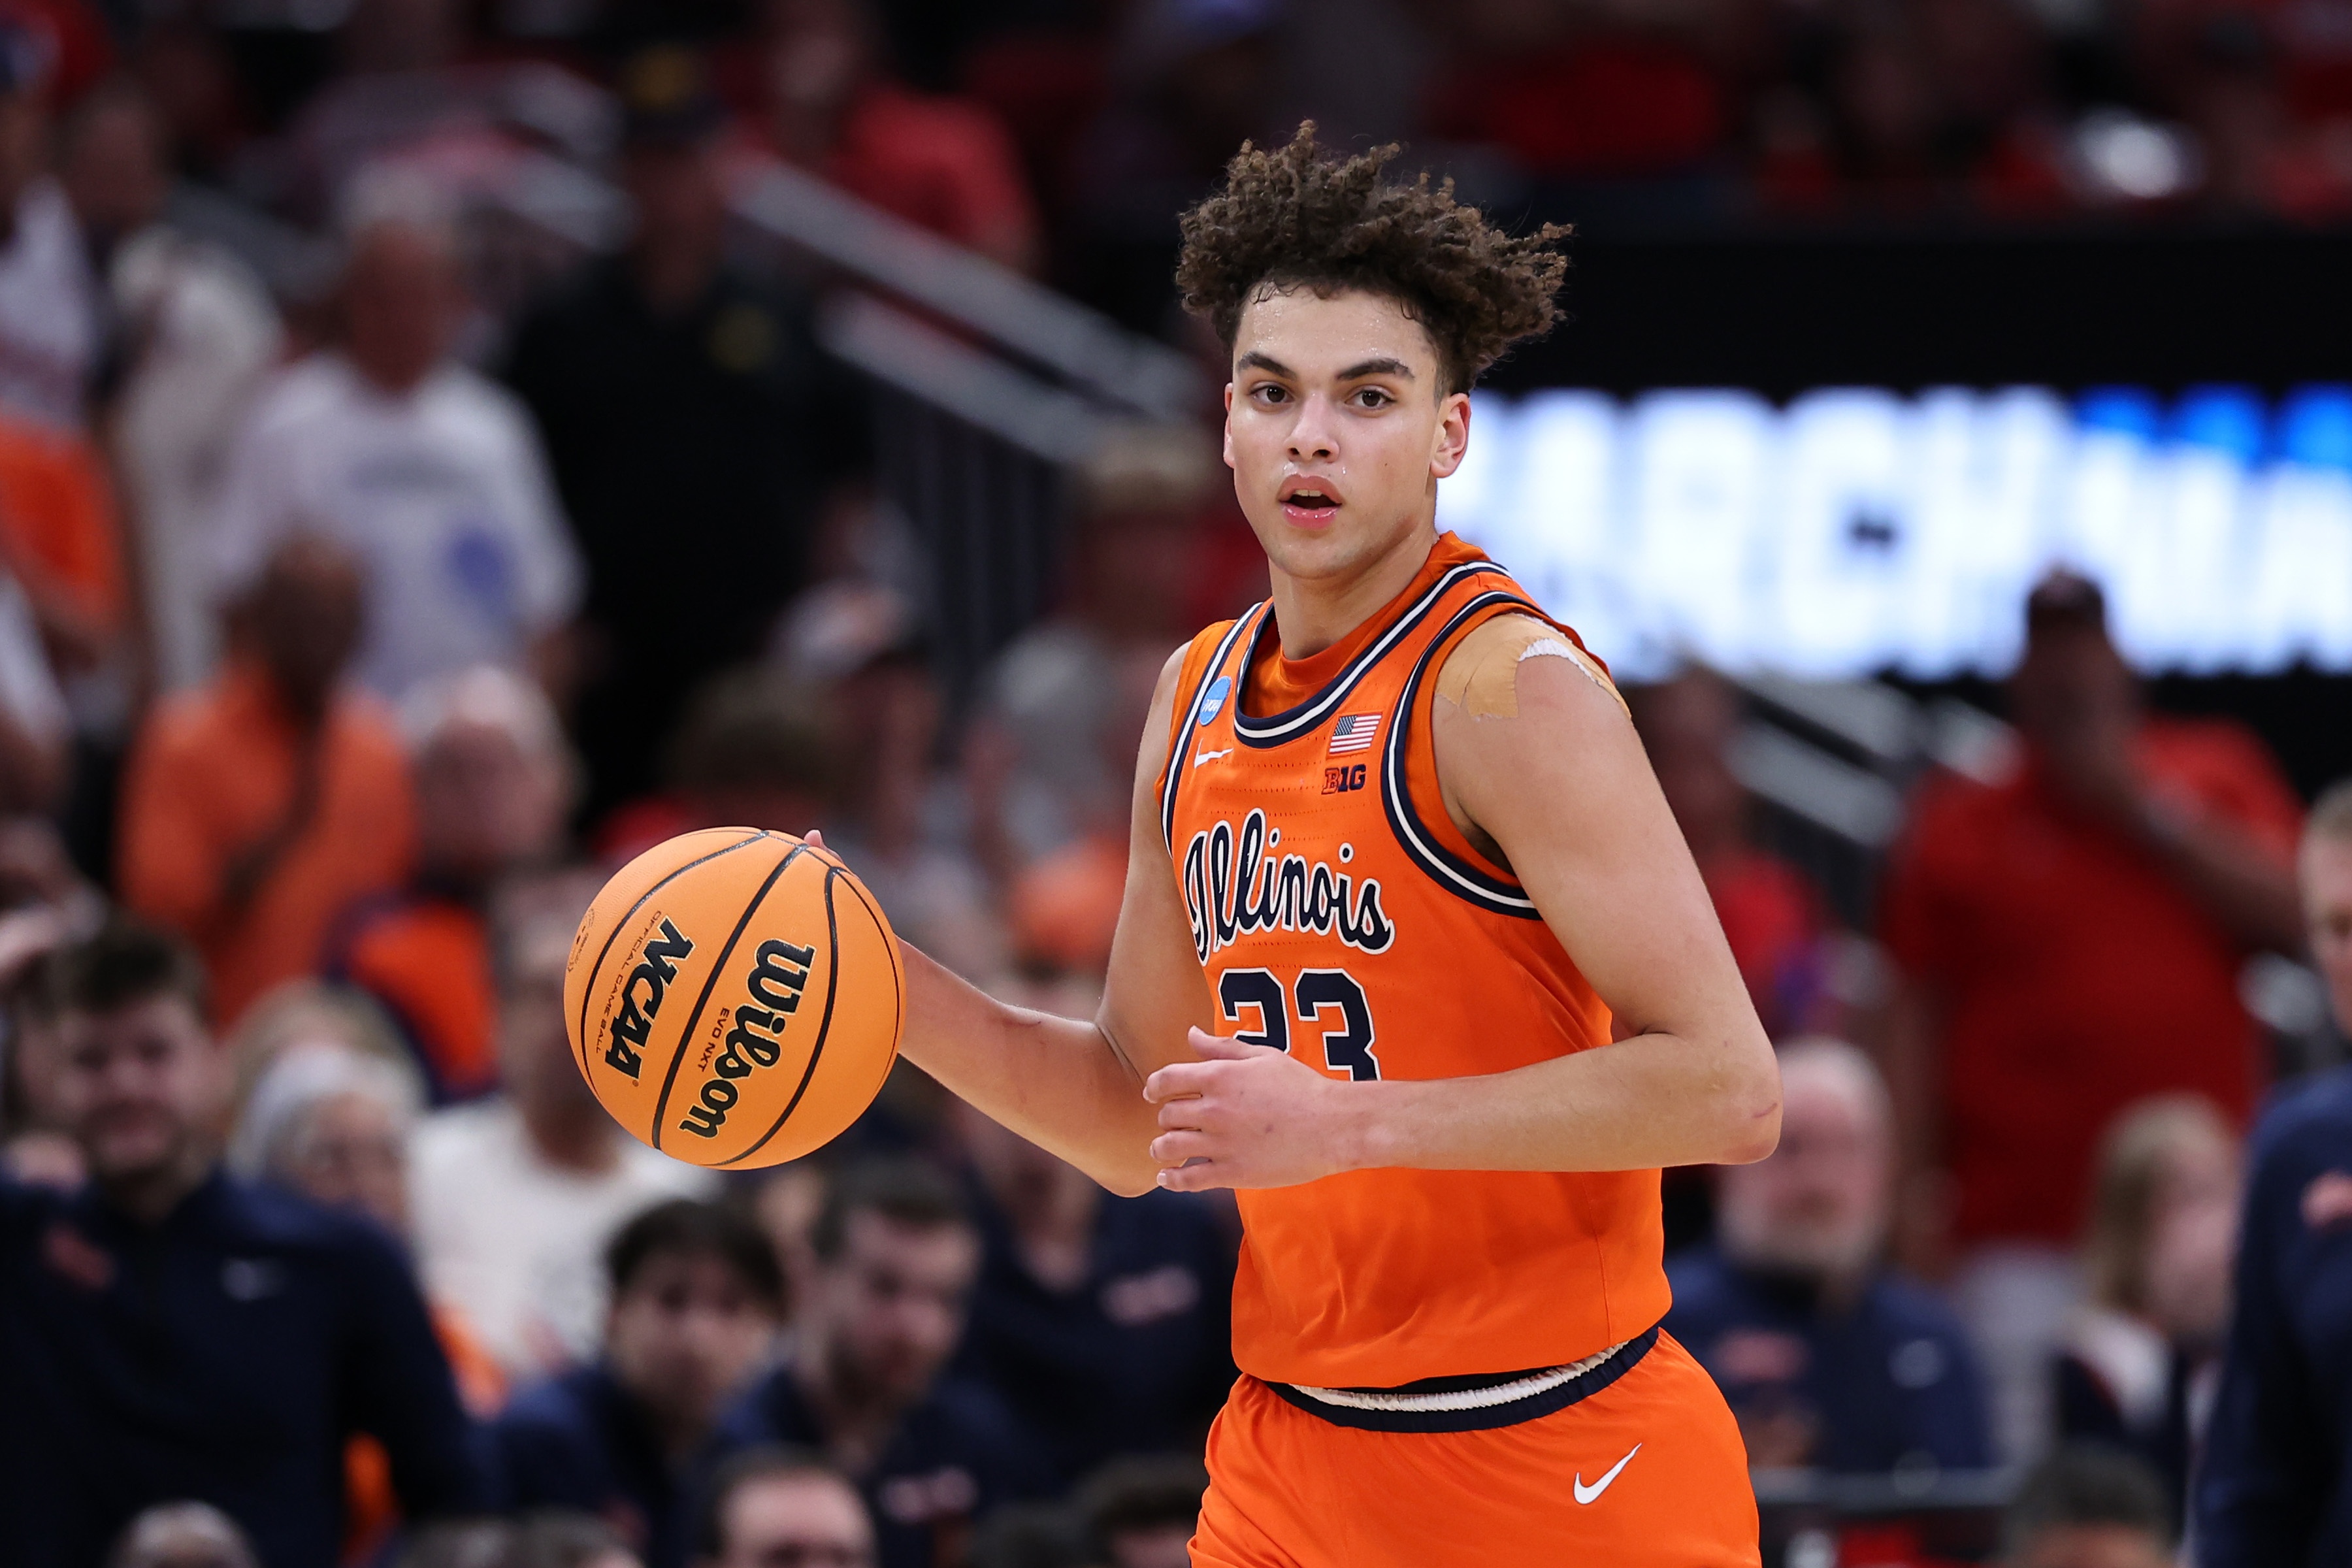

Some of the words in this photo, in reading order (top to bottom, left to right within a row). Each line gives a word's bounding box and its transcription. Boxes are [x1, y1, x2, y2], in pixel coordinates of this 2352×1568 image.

[1183, 808, 1394, 966] Illinois
[621, 910, 661, 970] OFFICIAL
[604, 974, 623, 1015] GAME
[604, 915, 696, 1080] NCAA
[596, 1019, 607, 1054] BALL
[678, 938, 817, 1139] Wilson
[711, 1007, 730, 1039] EVO
[698, 1041, 716, 1073] NXT
